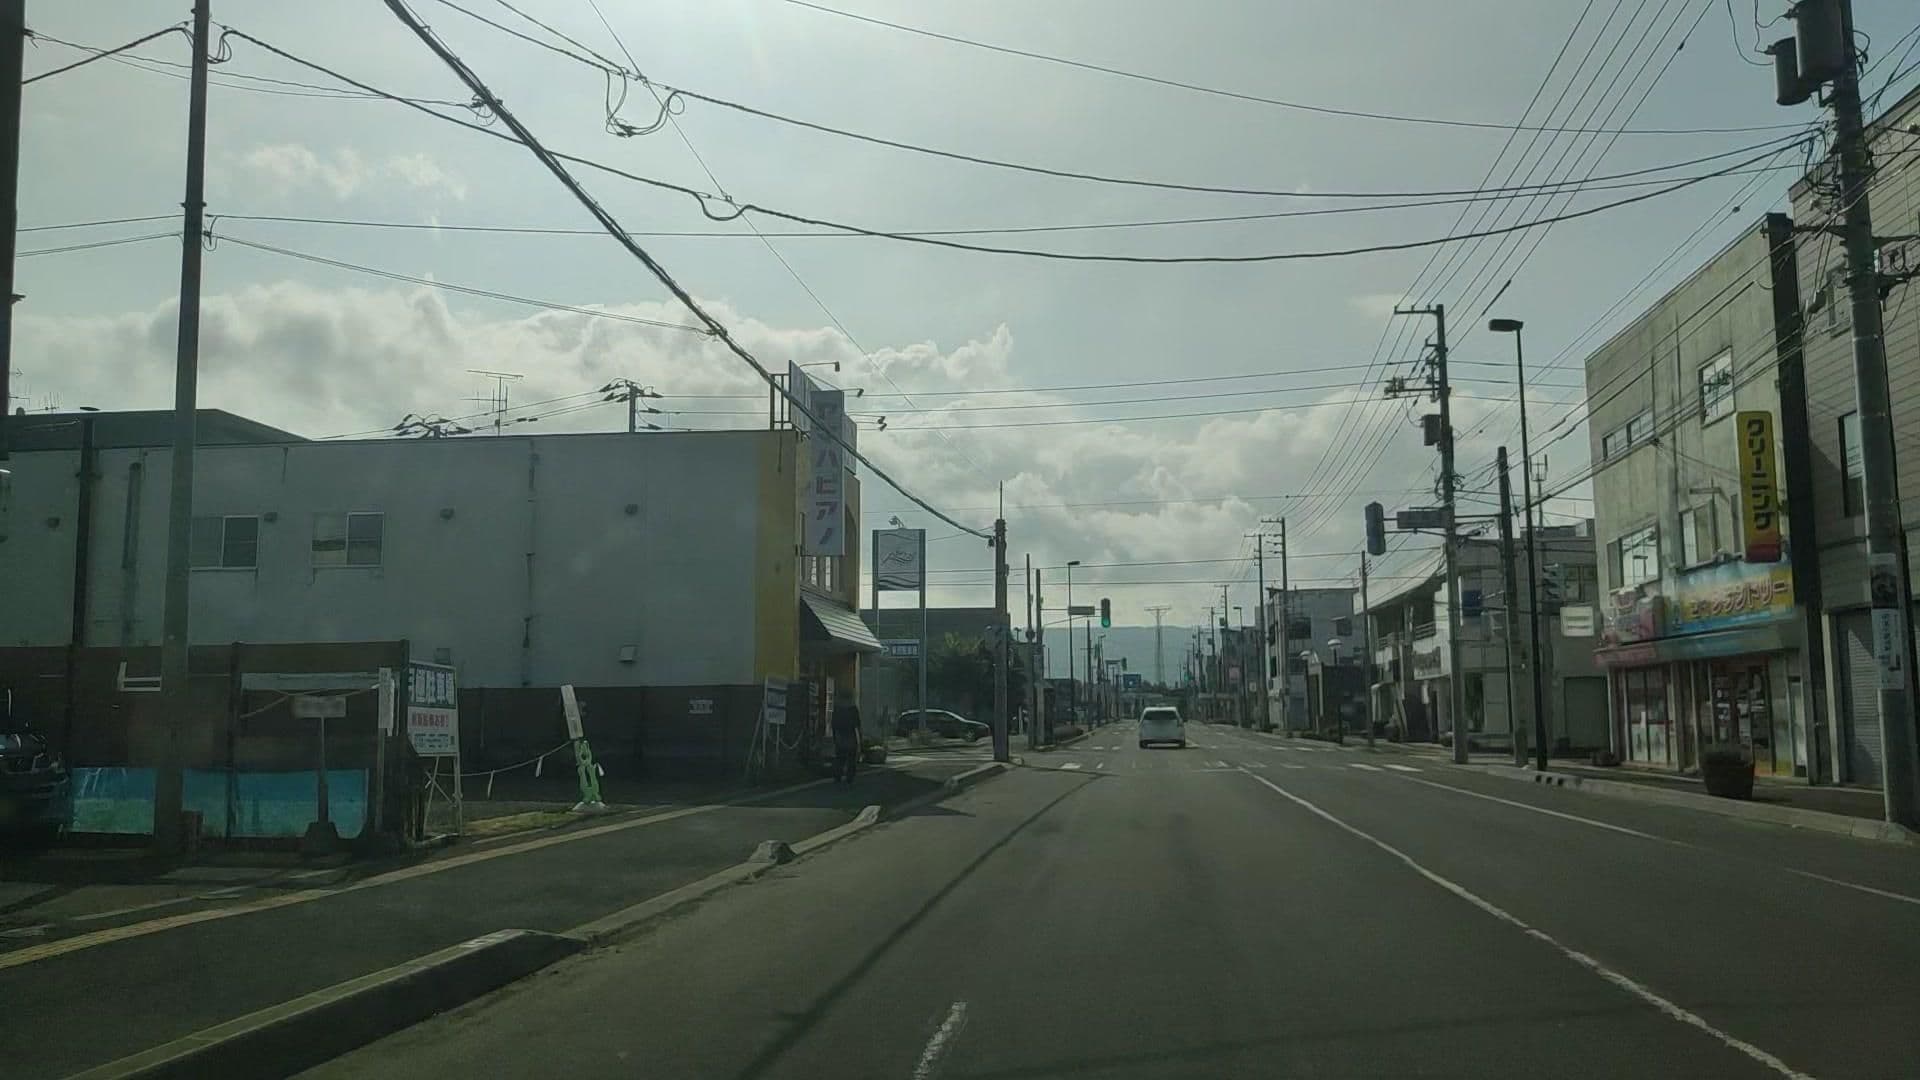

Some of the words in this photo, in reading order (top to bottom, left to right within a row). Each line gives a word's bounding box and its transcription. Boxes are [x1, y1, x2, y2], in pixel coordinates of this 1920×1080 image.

[815, 400, 838, 545] ハピアノ
[1747, 419, 1771, 529] クリーニング
